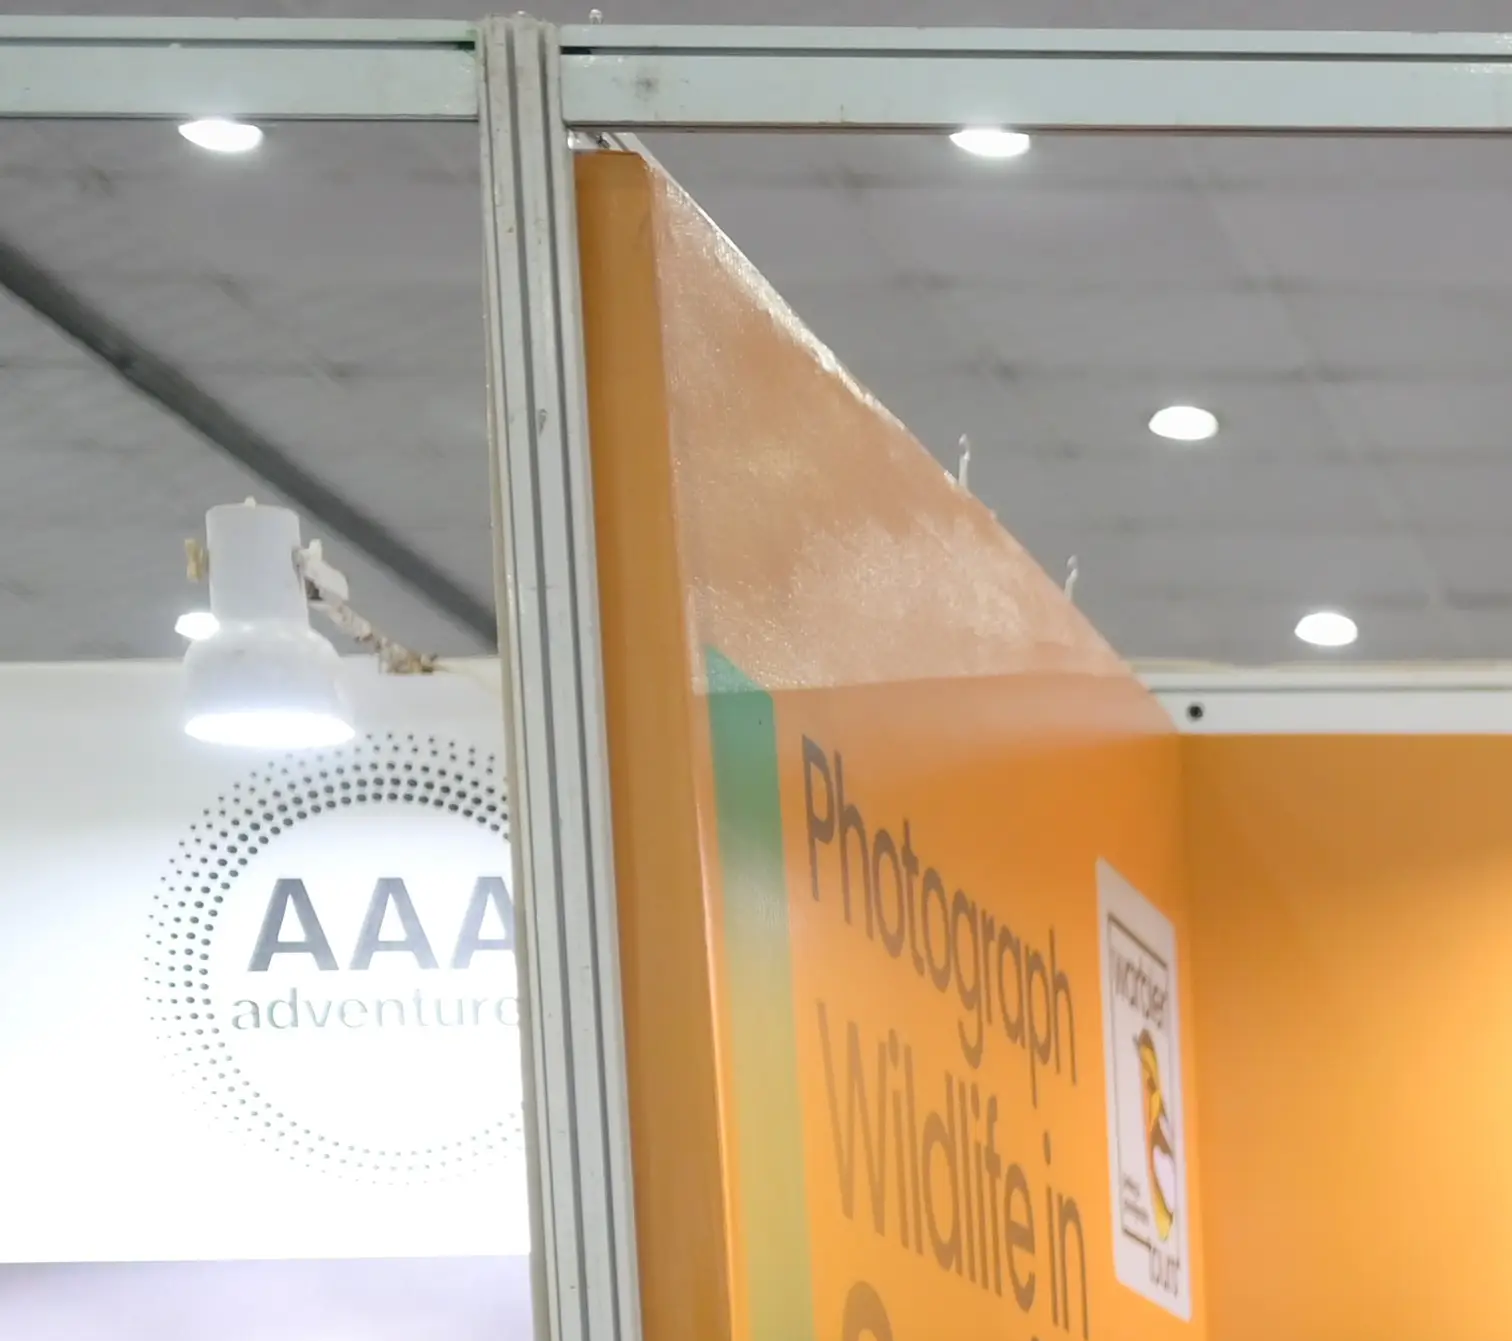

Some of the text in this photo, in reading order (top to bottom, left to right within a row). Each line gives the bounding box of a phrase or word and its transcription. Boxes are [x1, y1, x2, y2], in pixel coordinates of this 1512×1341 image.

[247, 877, 516, 972] AAA
[801, 734, 1078, 1109] Photograph
[815, 998, 1037, 1314] Wildlife
